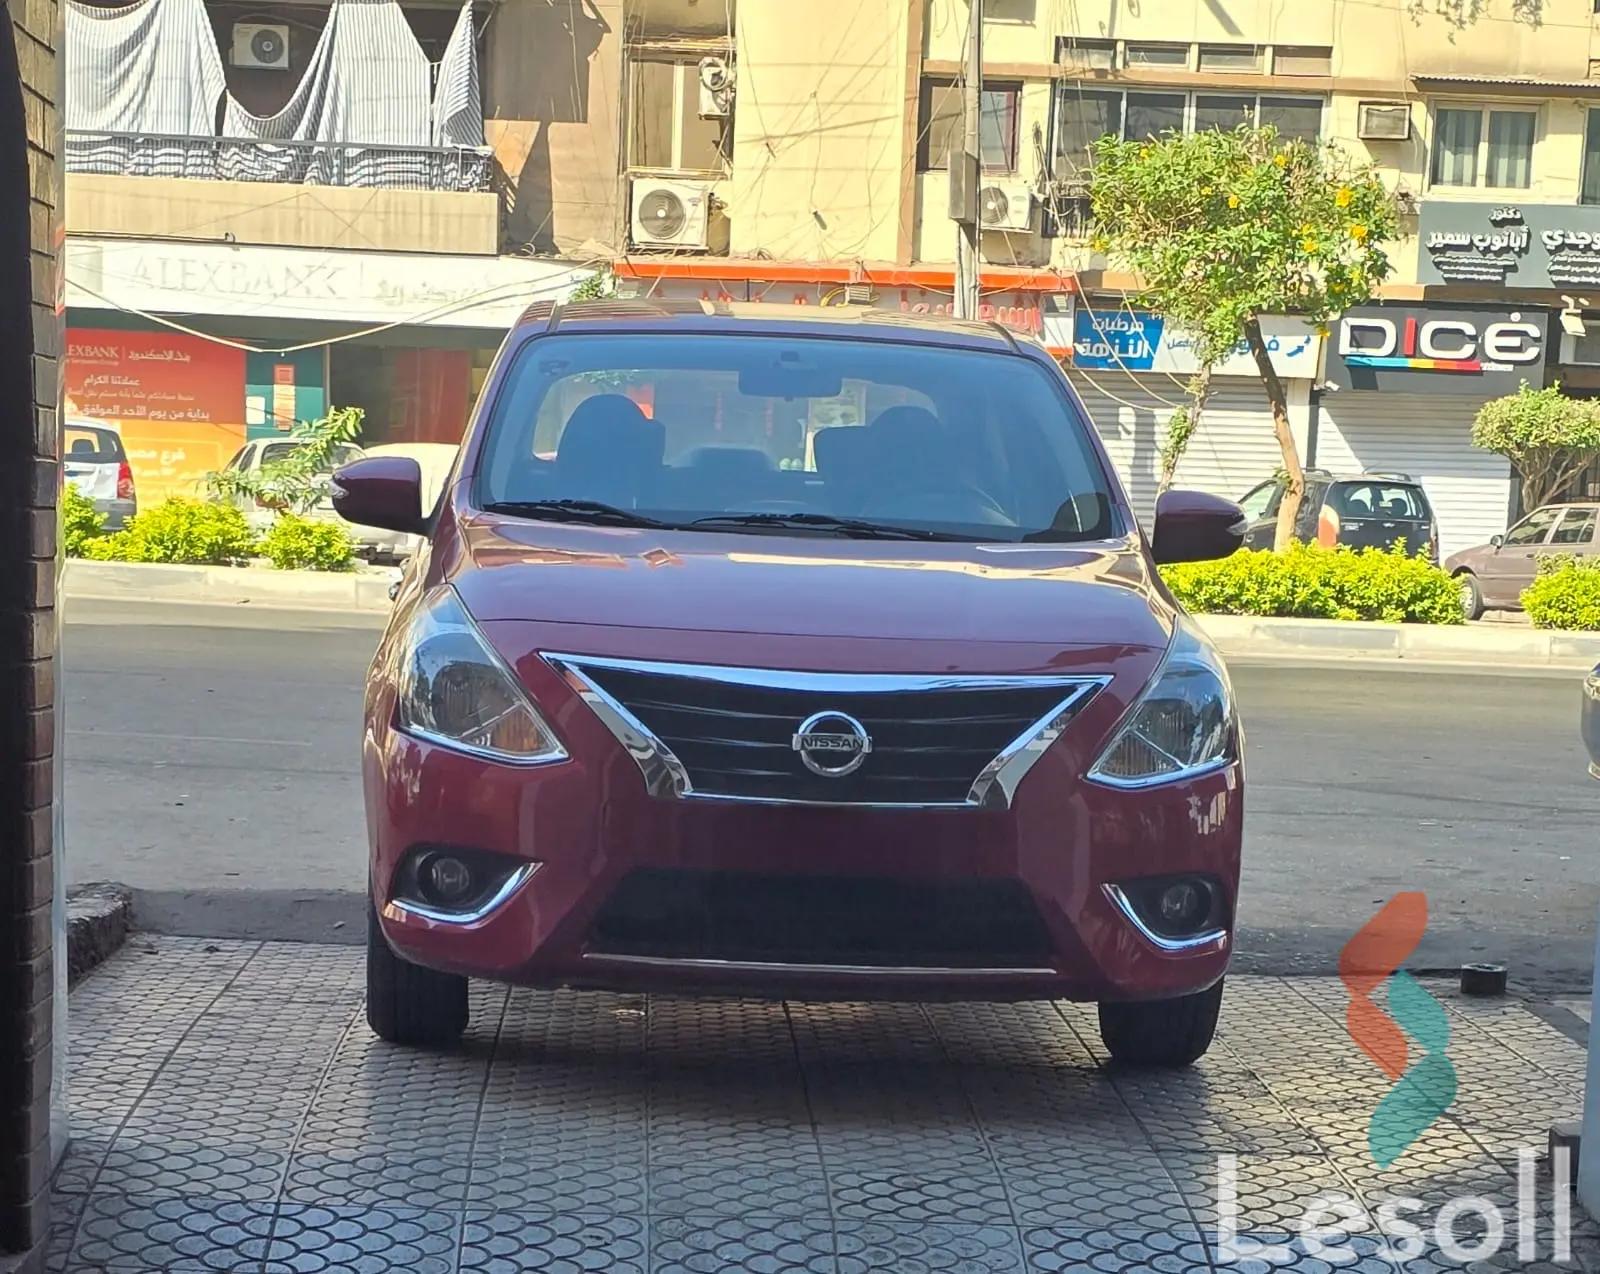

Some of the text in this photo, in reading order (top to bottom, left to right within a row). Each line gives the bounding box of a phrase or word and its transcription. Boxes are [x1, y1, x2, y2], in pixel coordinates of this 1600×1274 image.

[1490, 207, 1521, 221] دكتور
[1426, 231, 1471, 248] سمير
[132, 255, 347, 299] ALEXBANK
[801, 735, 864, 749] NISSAN
